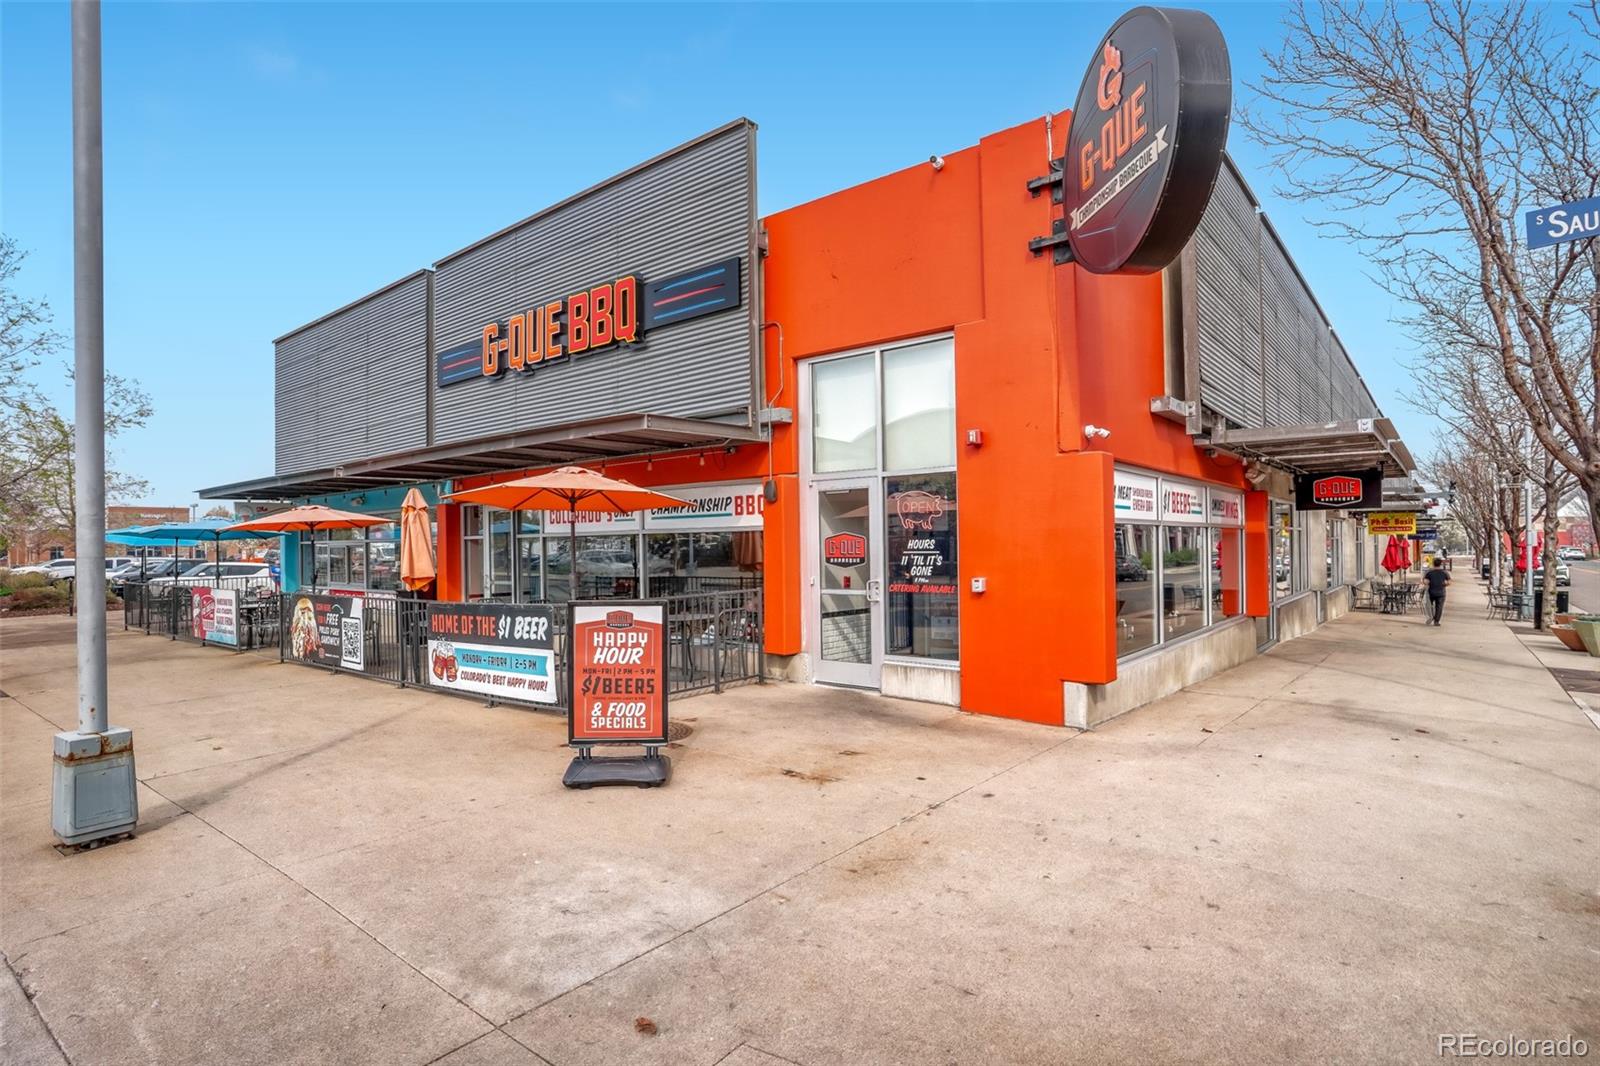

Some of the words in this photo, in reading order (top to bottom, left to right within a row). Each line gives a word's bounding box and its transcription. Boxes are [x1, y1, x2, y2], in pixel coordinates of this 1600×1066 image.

[1080, 81, 1148, 192] G-QUE
[1078, 177, 1119, 224] CHAMPIONSHIP
[1119, 146, 1154, 187] BARBEQUE
[1536, 215, 1544, 225] S
[482, 300, 564, 377] G-QUE
[567, 275, 637, 354] BBQ
[1117, 485, 1132, 500] MEAT
[1320, 481, 1356, 495] G-QUE
[651, 496, 733, 515] CHAMPIONSHIP
[902, 501, 935, 513] OPEN
[1171, 491, 1190, 514] BEERS
[829, 540, 861, 555] G-QUE
[907, 539, 935, 549] HOURS
[926, 556, 942, 565] IT'S
[911, 566, 933, 576] GONE
[889, 583, 919, 592] CATERING
[921, 585, 956, 593] AVAILABLE
[326, 613, 339, 625] FREE
[431, 614, 459, 634] HOME
[461, 615, 474, 636] OF
[476, 615, 496, 637] THE
[498, 614, 511, 639] $1
[513, 616, 548, 641] BEER
[593, 632, 648, 647] HAPPY
[488, 655, 507, 667] FRIDAY
[528, 661, 537, 670] PM
[593, 647, 644, 664] HOUR
[460, 670, 492, 685] COLORADO'S
[493, 674, 506, 686] BEST
[507, 676, 526, 688] HAPPY
[527, 680, 548, 692] HOUR!
[602, 678, 655, 694] BEERS
[591, 702, 602, 716] &
[607, 702, 646, 716] FOOD
[591, 717, 646, 728] SPECIALS
